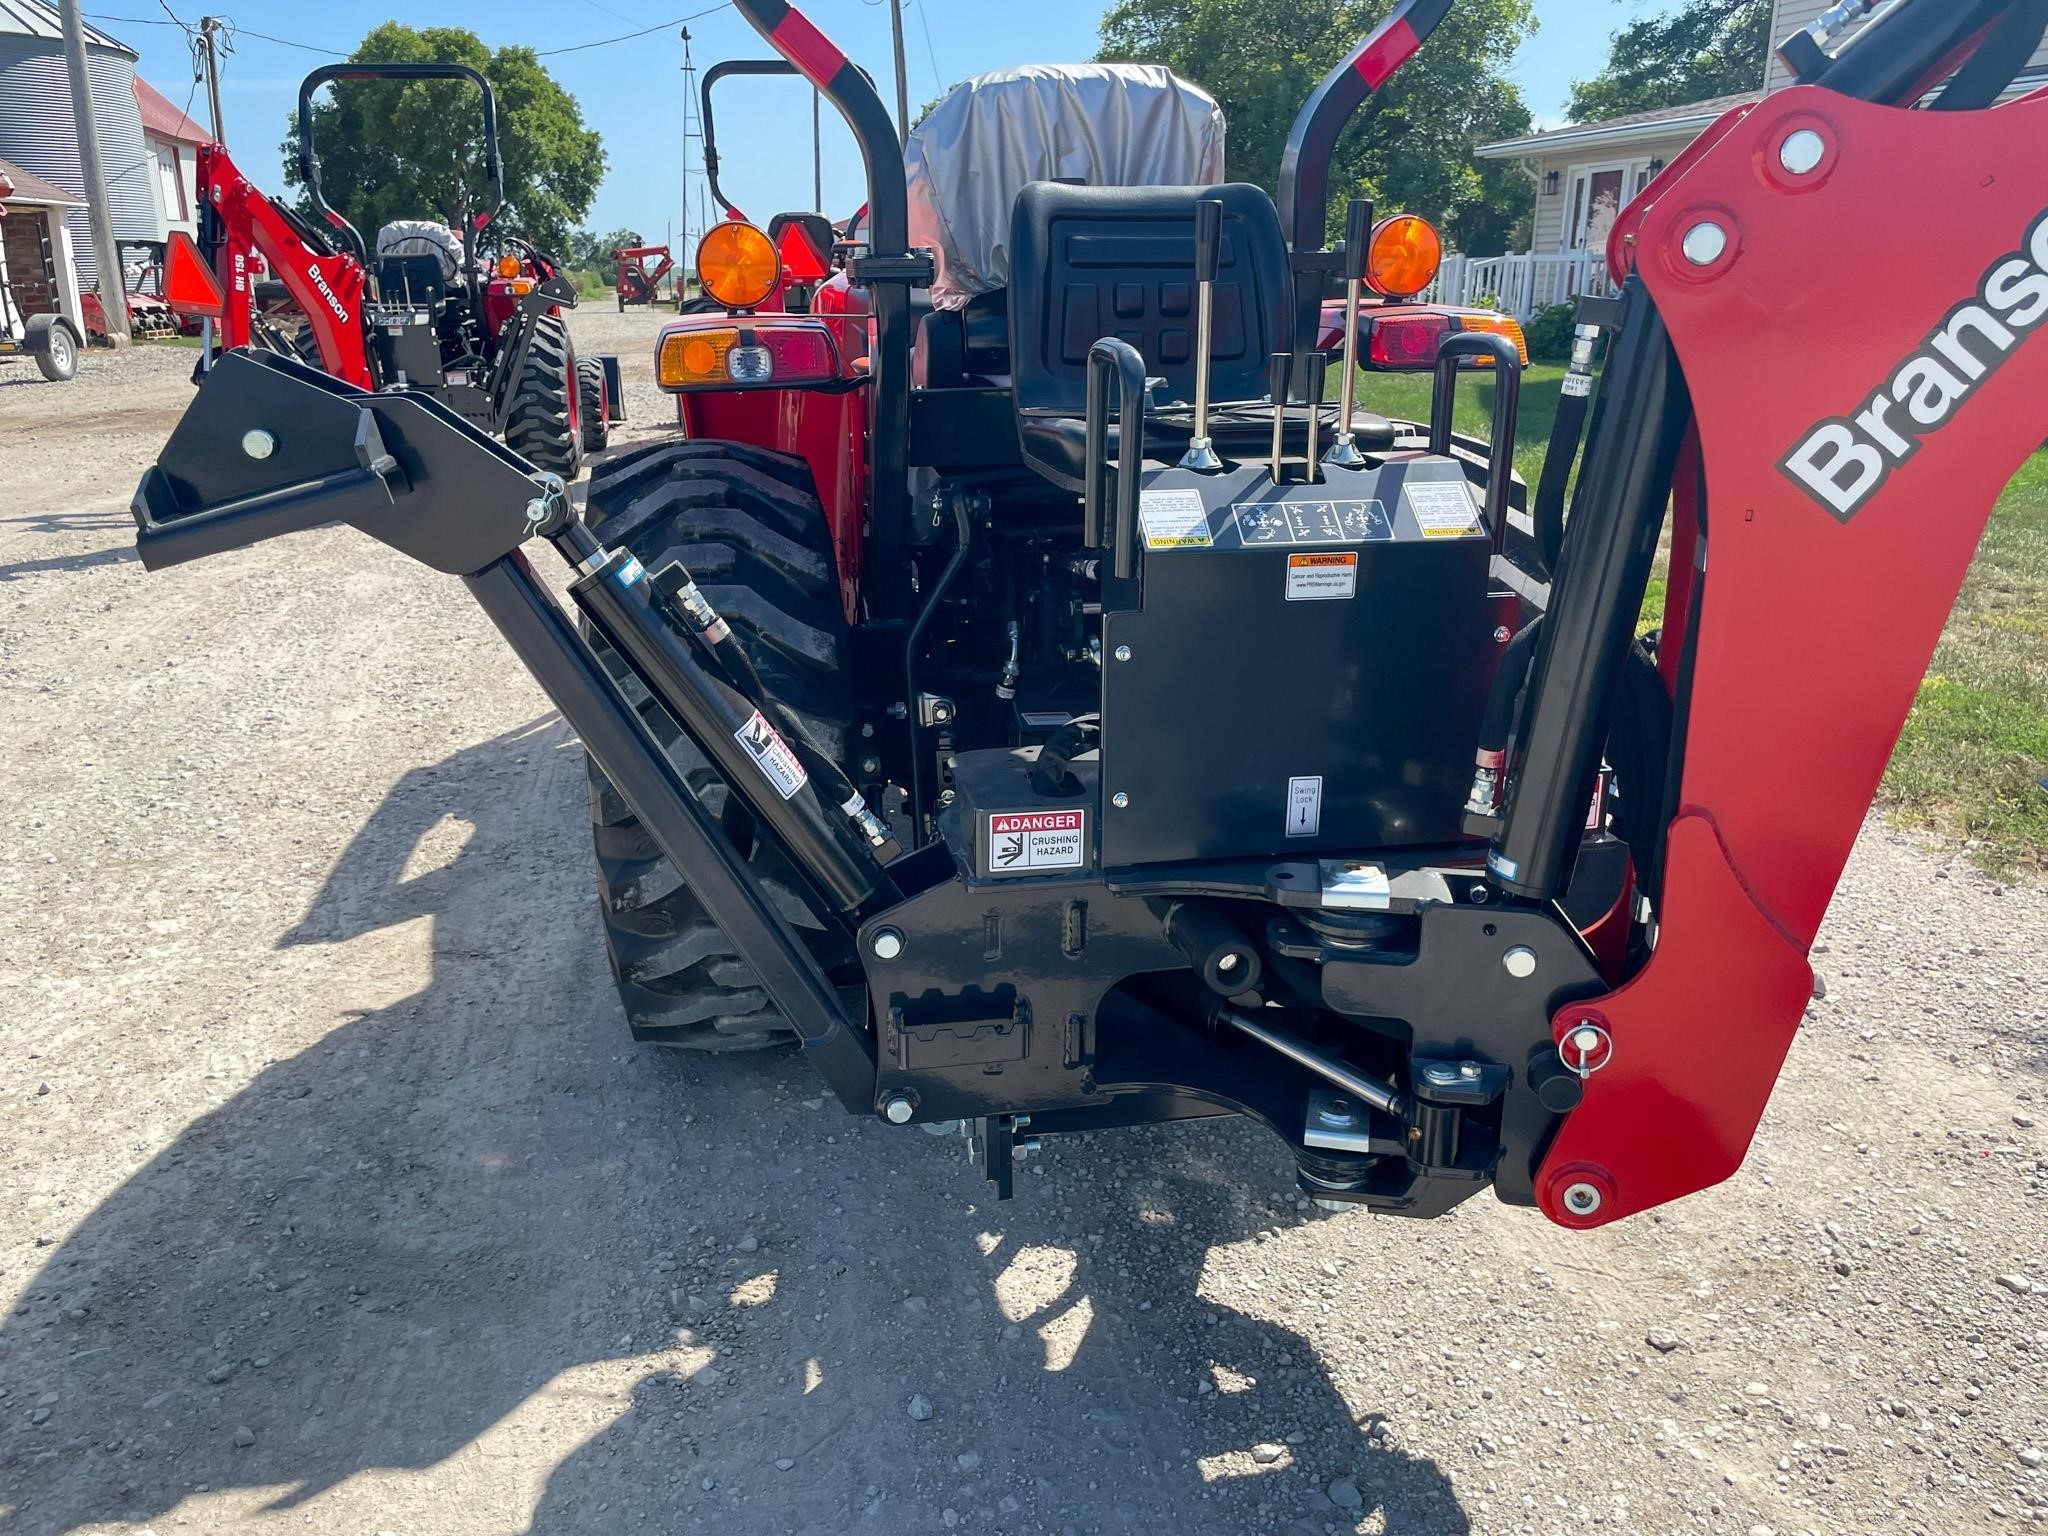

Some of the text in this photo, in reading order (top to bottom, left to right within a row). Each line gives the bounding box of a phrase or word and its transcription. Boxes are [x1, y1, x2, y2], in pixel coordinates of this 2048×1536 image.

[235, 254, 245, 291] BH 150
[307, 264, 349, 323] Branson
[1785, 216, 2048, 513] Brans
[1310, 556, 1347, 565] WARNING
[769, 757, 793, 785] HAZARD
[772, 747, 801, 783] CRUSHING
[1294, 786, 1316, 795] Swing
[1295, 795, 1313, 804] Lock
[1010, 815, 1077, 830] DANGER
[1031, 835, 1079, 846] CRUSHING
[1036, 846, 1074, 856] HAZARD
